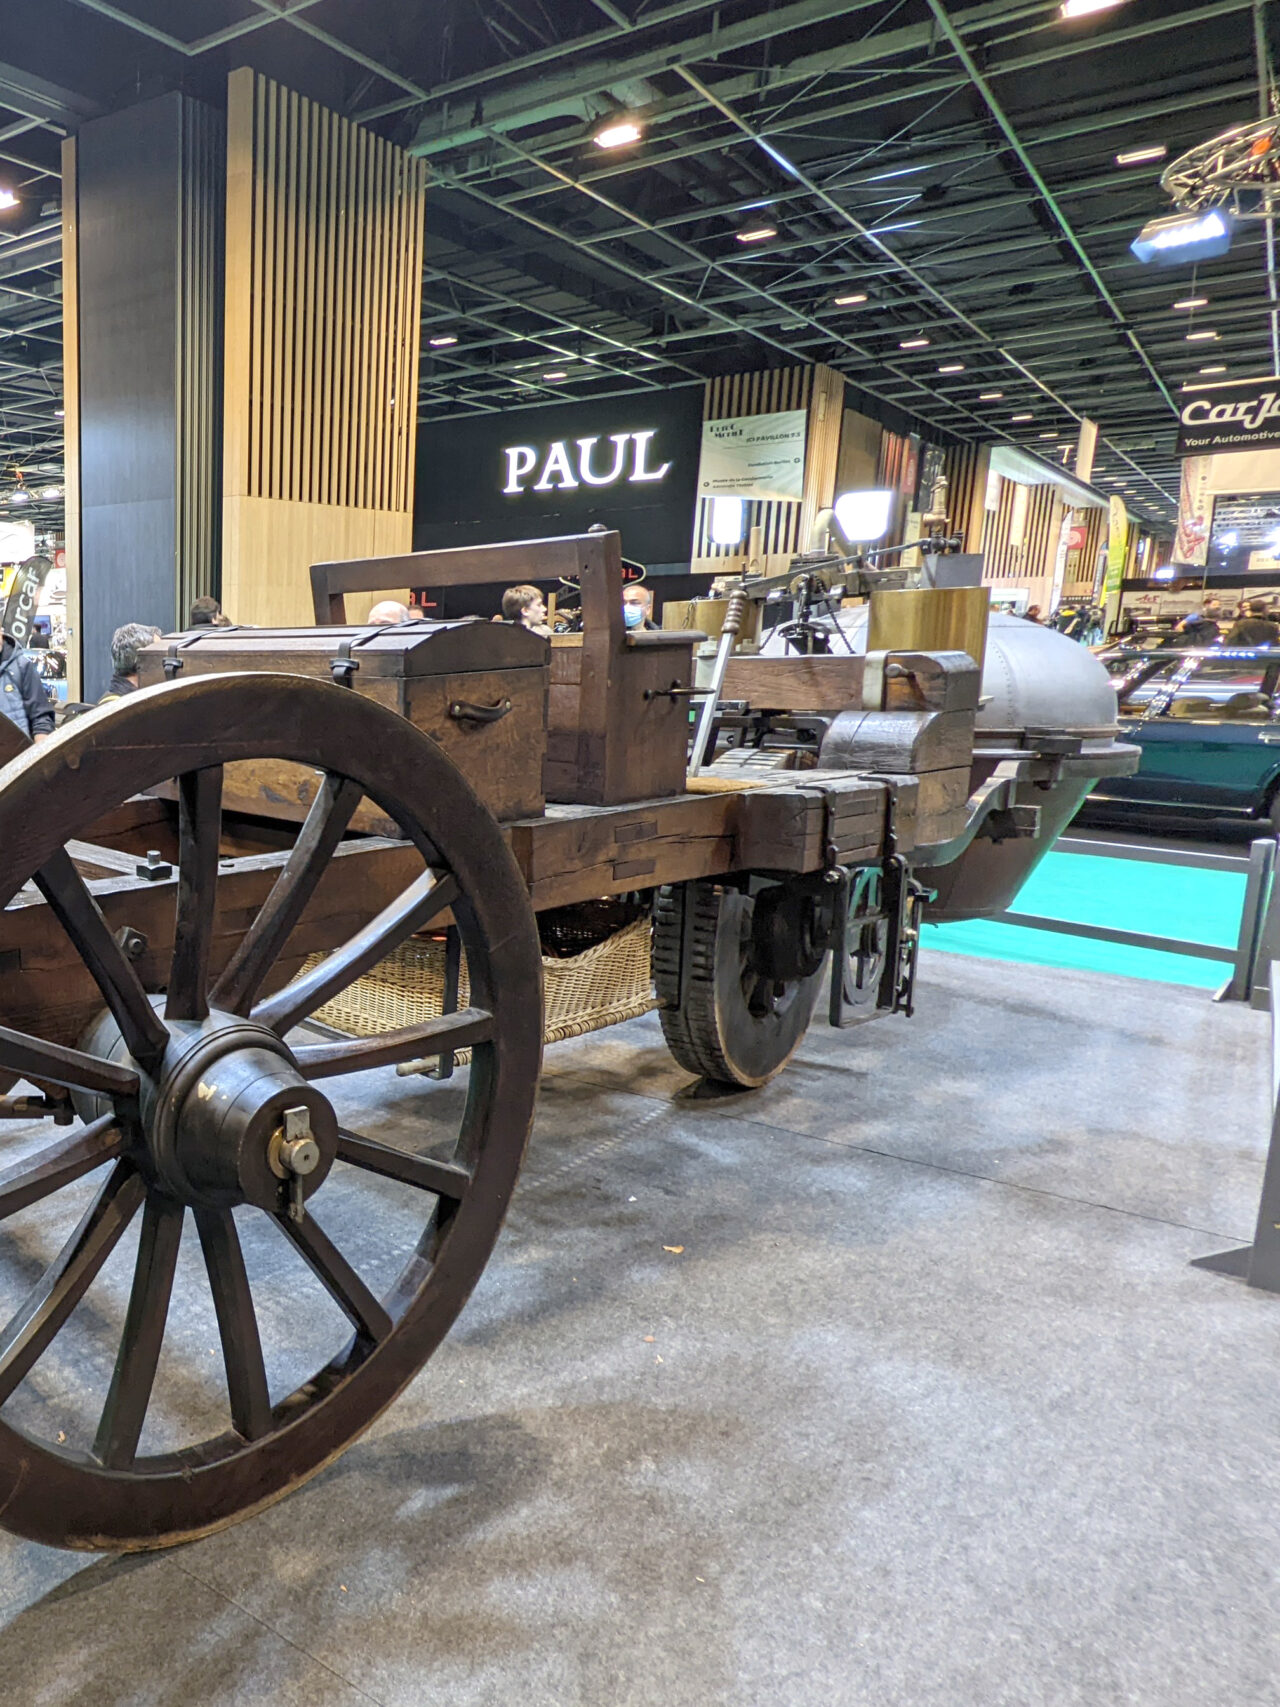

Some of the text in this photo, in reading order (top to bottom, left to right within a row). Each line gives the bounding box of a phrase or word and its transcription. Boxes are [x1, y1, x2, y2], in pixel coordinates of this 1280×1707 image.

[1184, 430, 1280, 447] Your Automotive
[502, 430, 672, 495] PAUL
